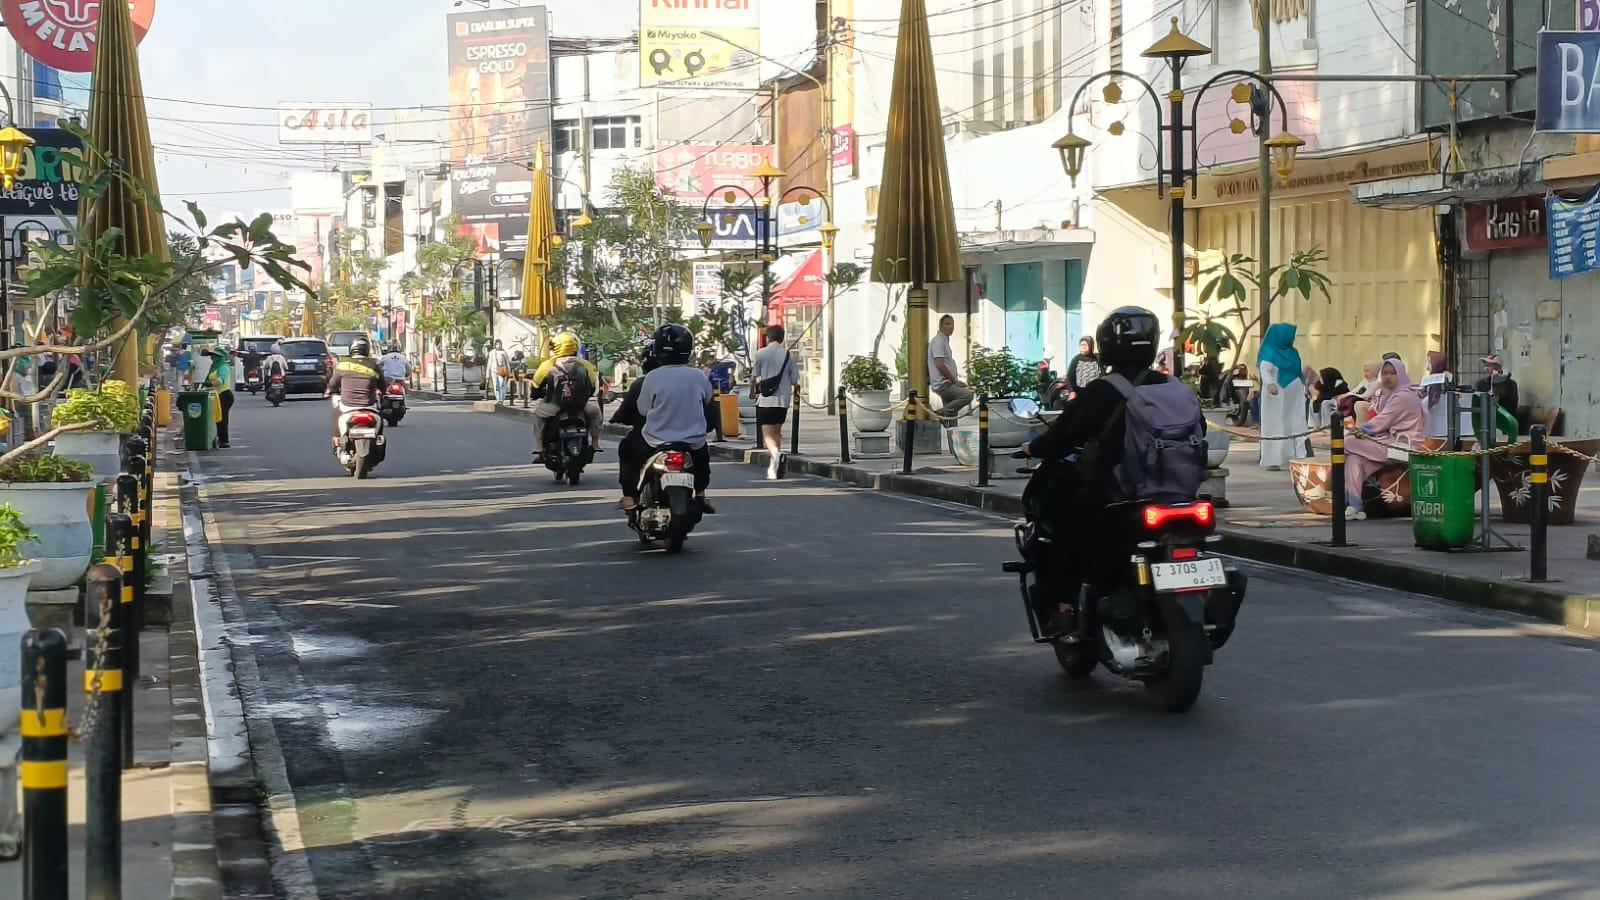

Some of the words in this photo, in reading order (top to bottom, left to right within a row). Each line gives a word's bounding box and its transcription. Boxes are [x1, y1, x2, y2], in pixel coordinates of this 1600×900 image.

[658, 30, 697, 41] Miyako
[467, 42, 527, 60] ESPRESSO
[479, 60, 514, 73] GOLD
[1154, 566, 1162, 577] Z
[1169, 562, 1198, 575] 3709
